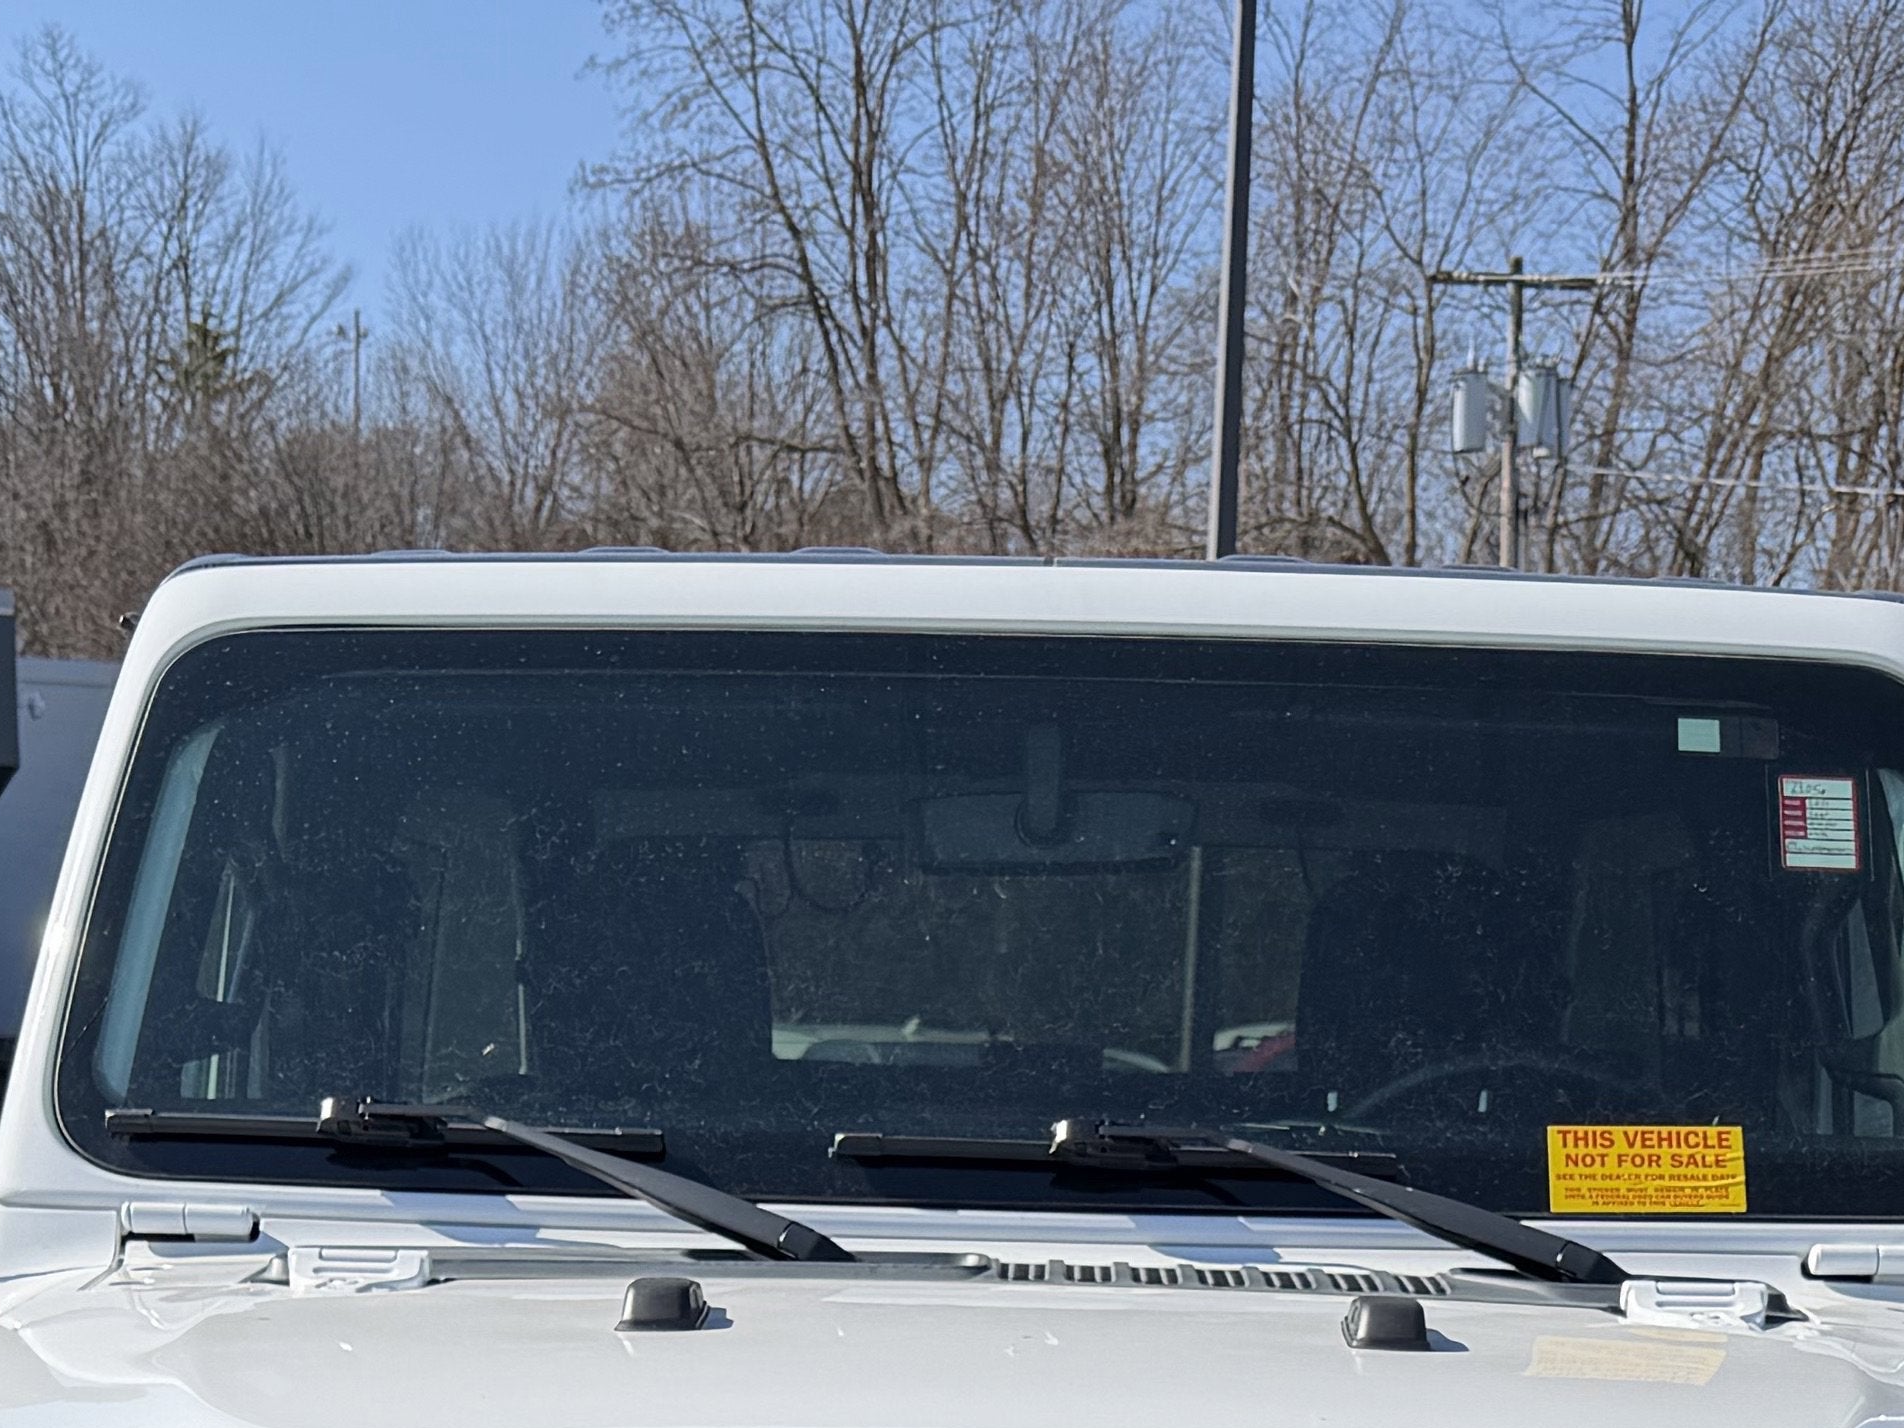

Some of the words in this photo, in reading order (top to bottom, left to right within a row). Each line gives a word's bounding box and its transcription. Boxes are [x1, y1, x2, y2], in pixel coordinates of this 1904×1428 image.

[1556, 1130, 1615, 1149] THIS
[1623, 1130, 1732, 1150] VEHICLE
[1565, 1153, 1609, 1168] NOT
[1617, 1153, 1662, 1168] FOR
[1670, 1153, 1728, 1169] SALE
[1555, 1173, 1576, 1181] SEE
[1579, 1173, 1597, 1181] THE
[1600, 1173, 1641, 1181] DEALER
[1645, 1173, 1665, 1182] FOR
[1668, 1173, 1708, 1182] RESALE
